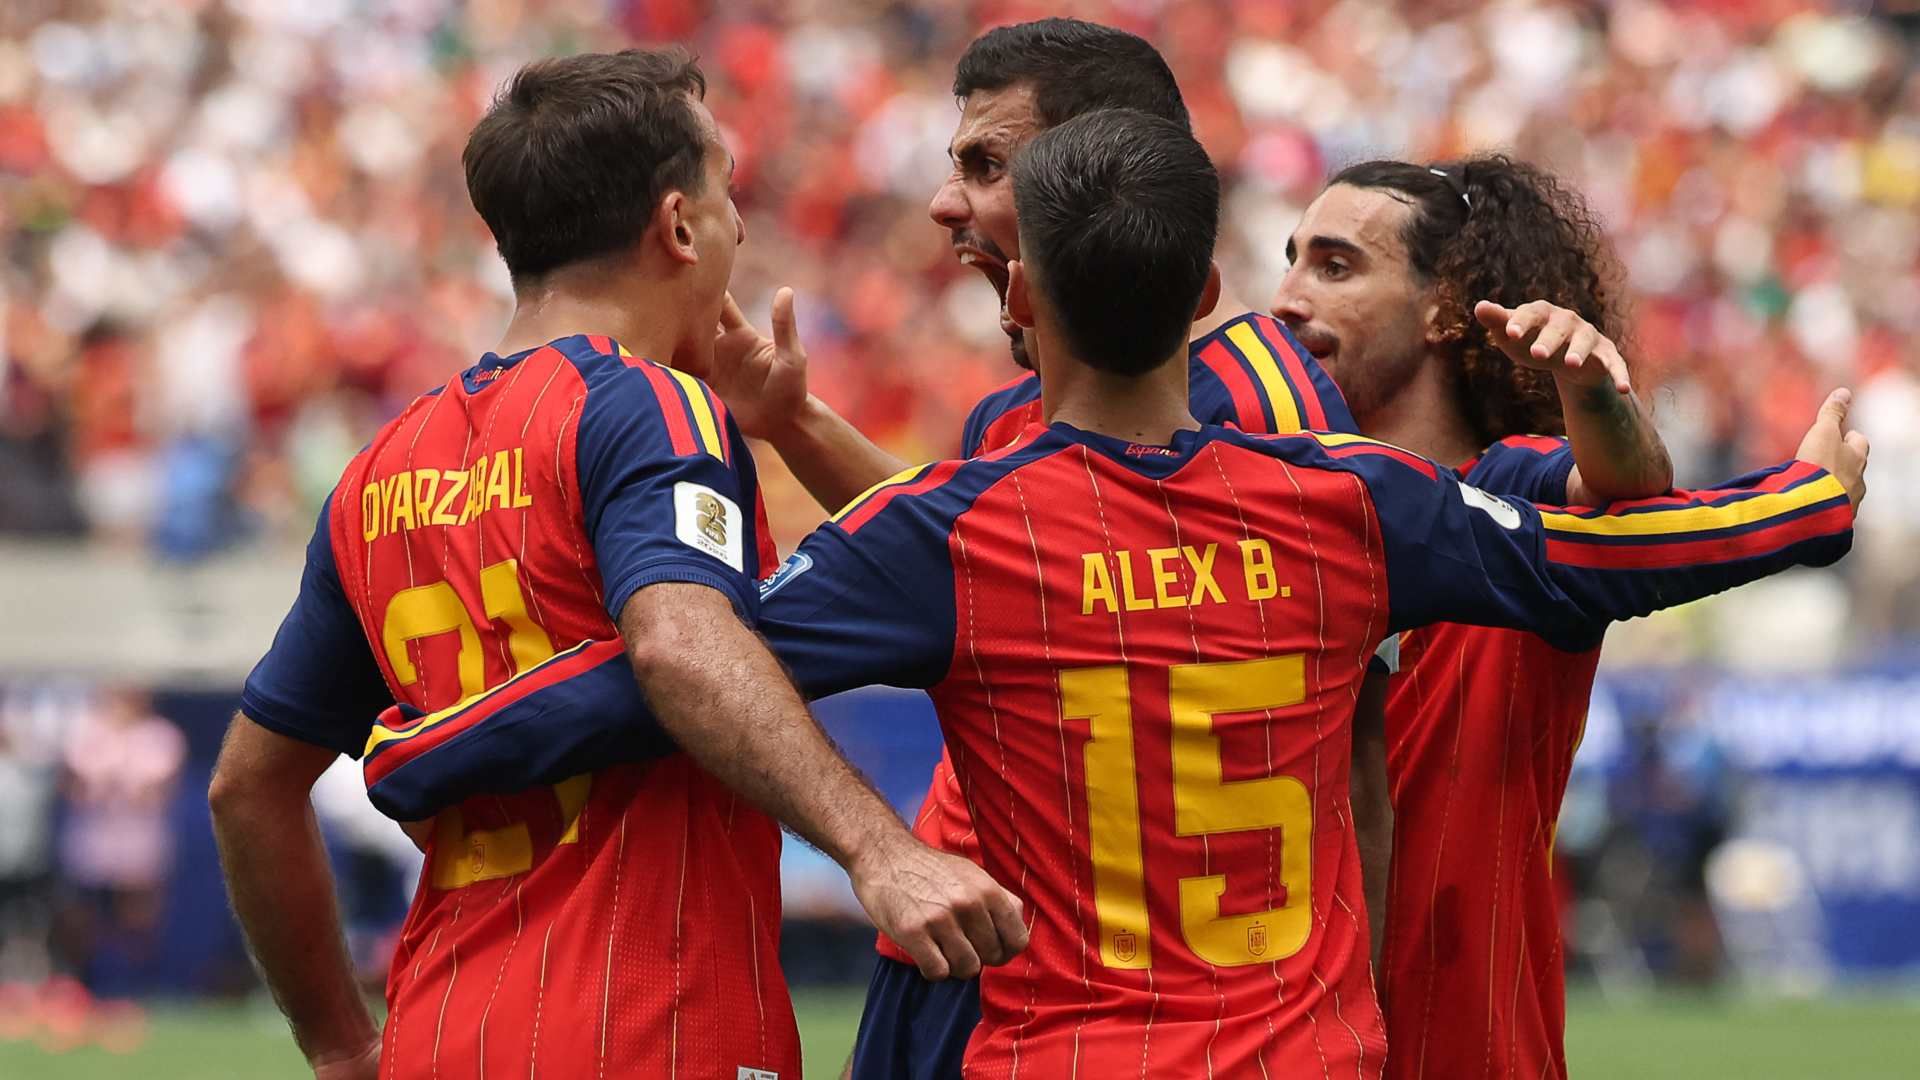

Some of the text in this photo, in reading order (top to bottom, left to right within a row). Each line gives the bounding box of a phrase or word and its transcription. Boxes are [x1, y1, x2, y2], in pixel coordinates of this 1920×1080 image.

[362, 447, 533, 543] OYARZABAL
[1081, 538, 1291, 615] ALEX B.
[1060, 654, 1314, 970] 15
